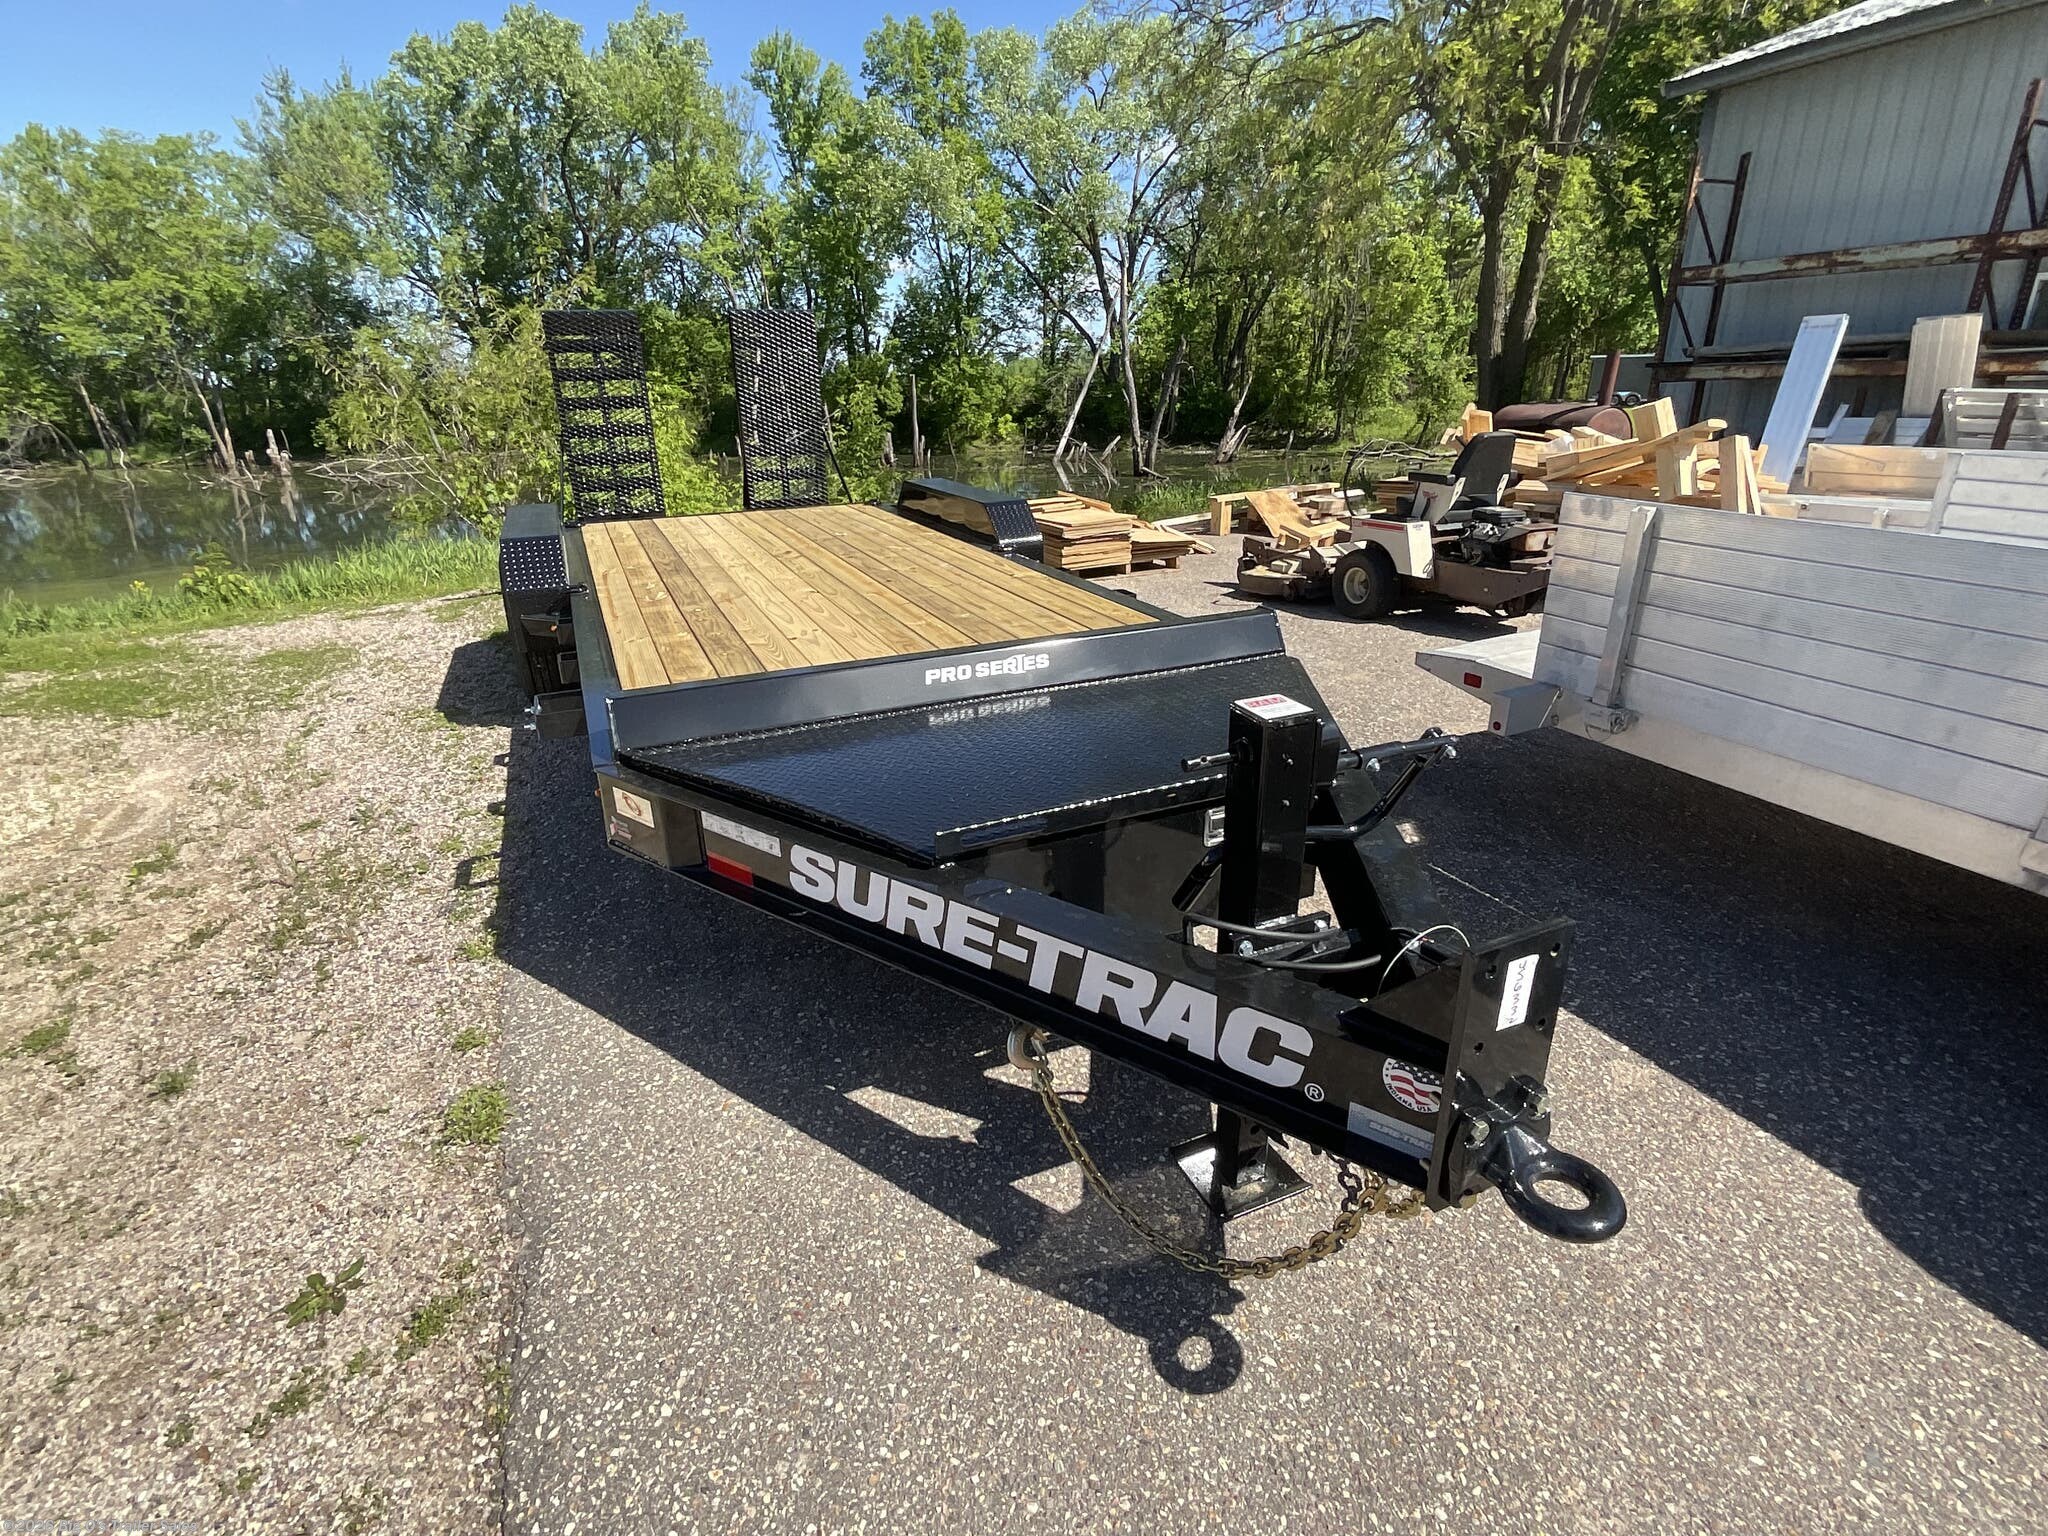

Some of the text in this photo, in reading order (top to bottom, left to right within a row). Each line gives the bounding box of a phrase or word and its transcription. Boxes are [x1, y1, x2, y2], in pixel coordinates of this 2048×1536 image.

[925, 653, 1050, 686] PRO SERIES
[788, 844, 1313, 1088] SURE-TRAC
